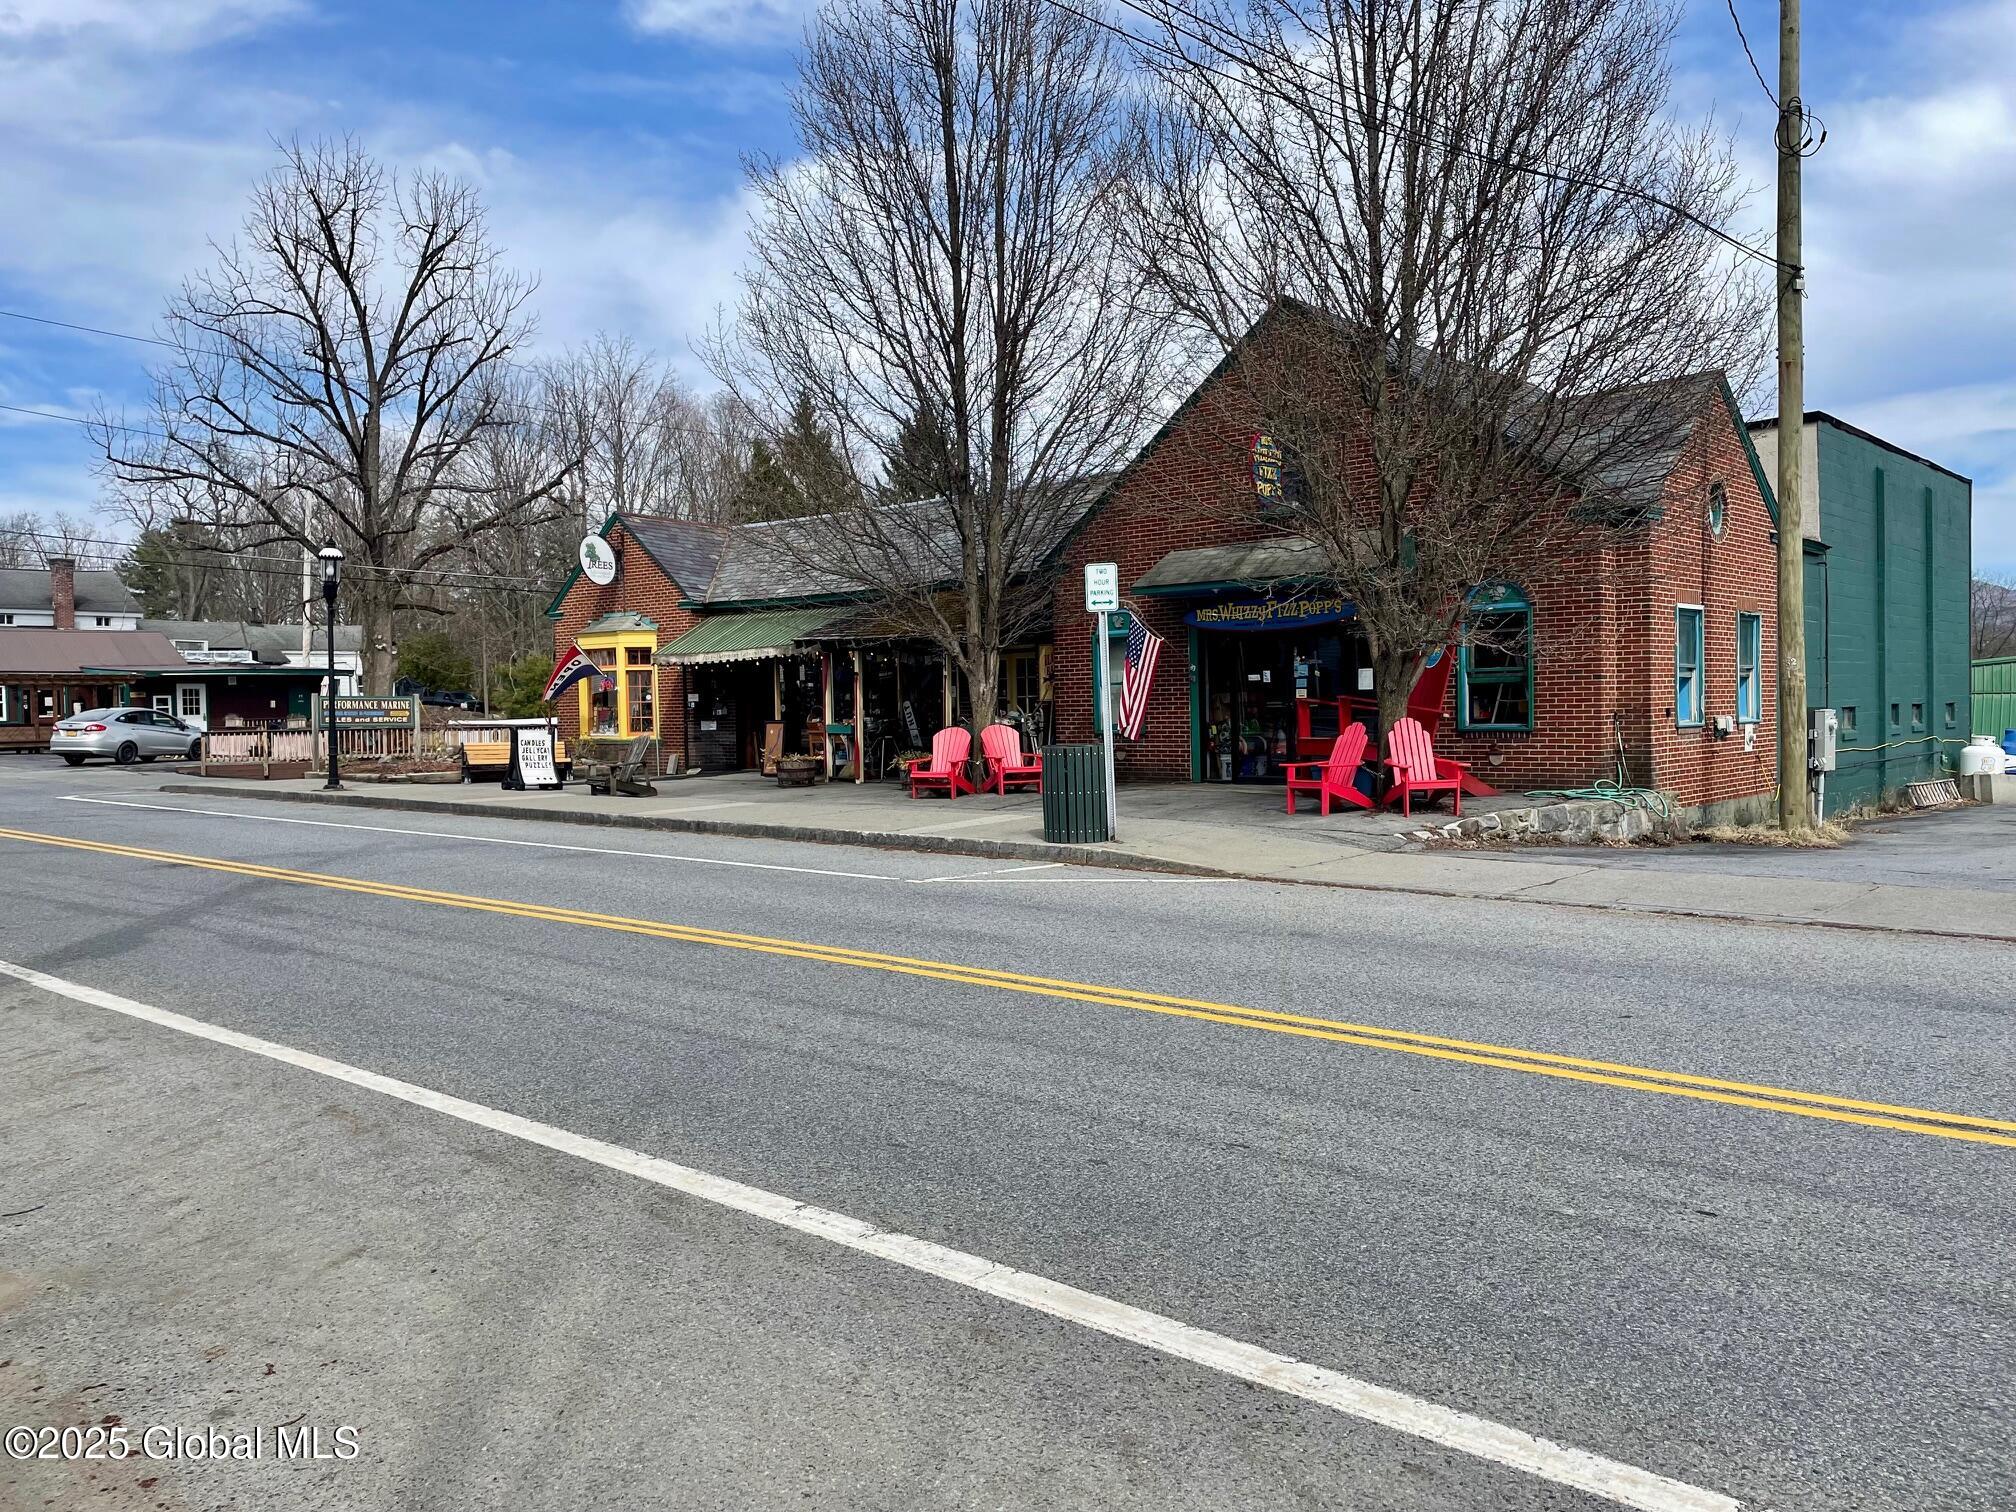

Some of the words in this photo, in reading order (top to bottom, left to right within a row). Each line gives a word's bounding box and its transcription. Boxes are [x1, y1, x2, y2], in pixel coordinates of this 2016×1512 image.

[587, 560, 614, 570] TREES
[549, 660, 582, 691] OPEN
[380, 700, 411, 710] MARINE
[520, 739, 546, 747] CANDLES
